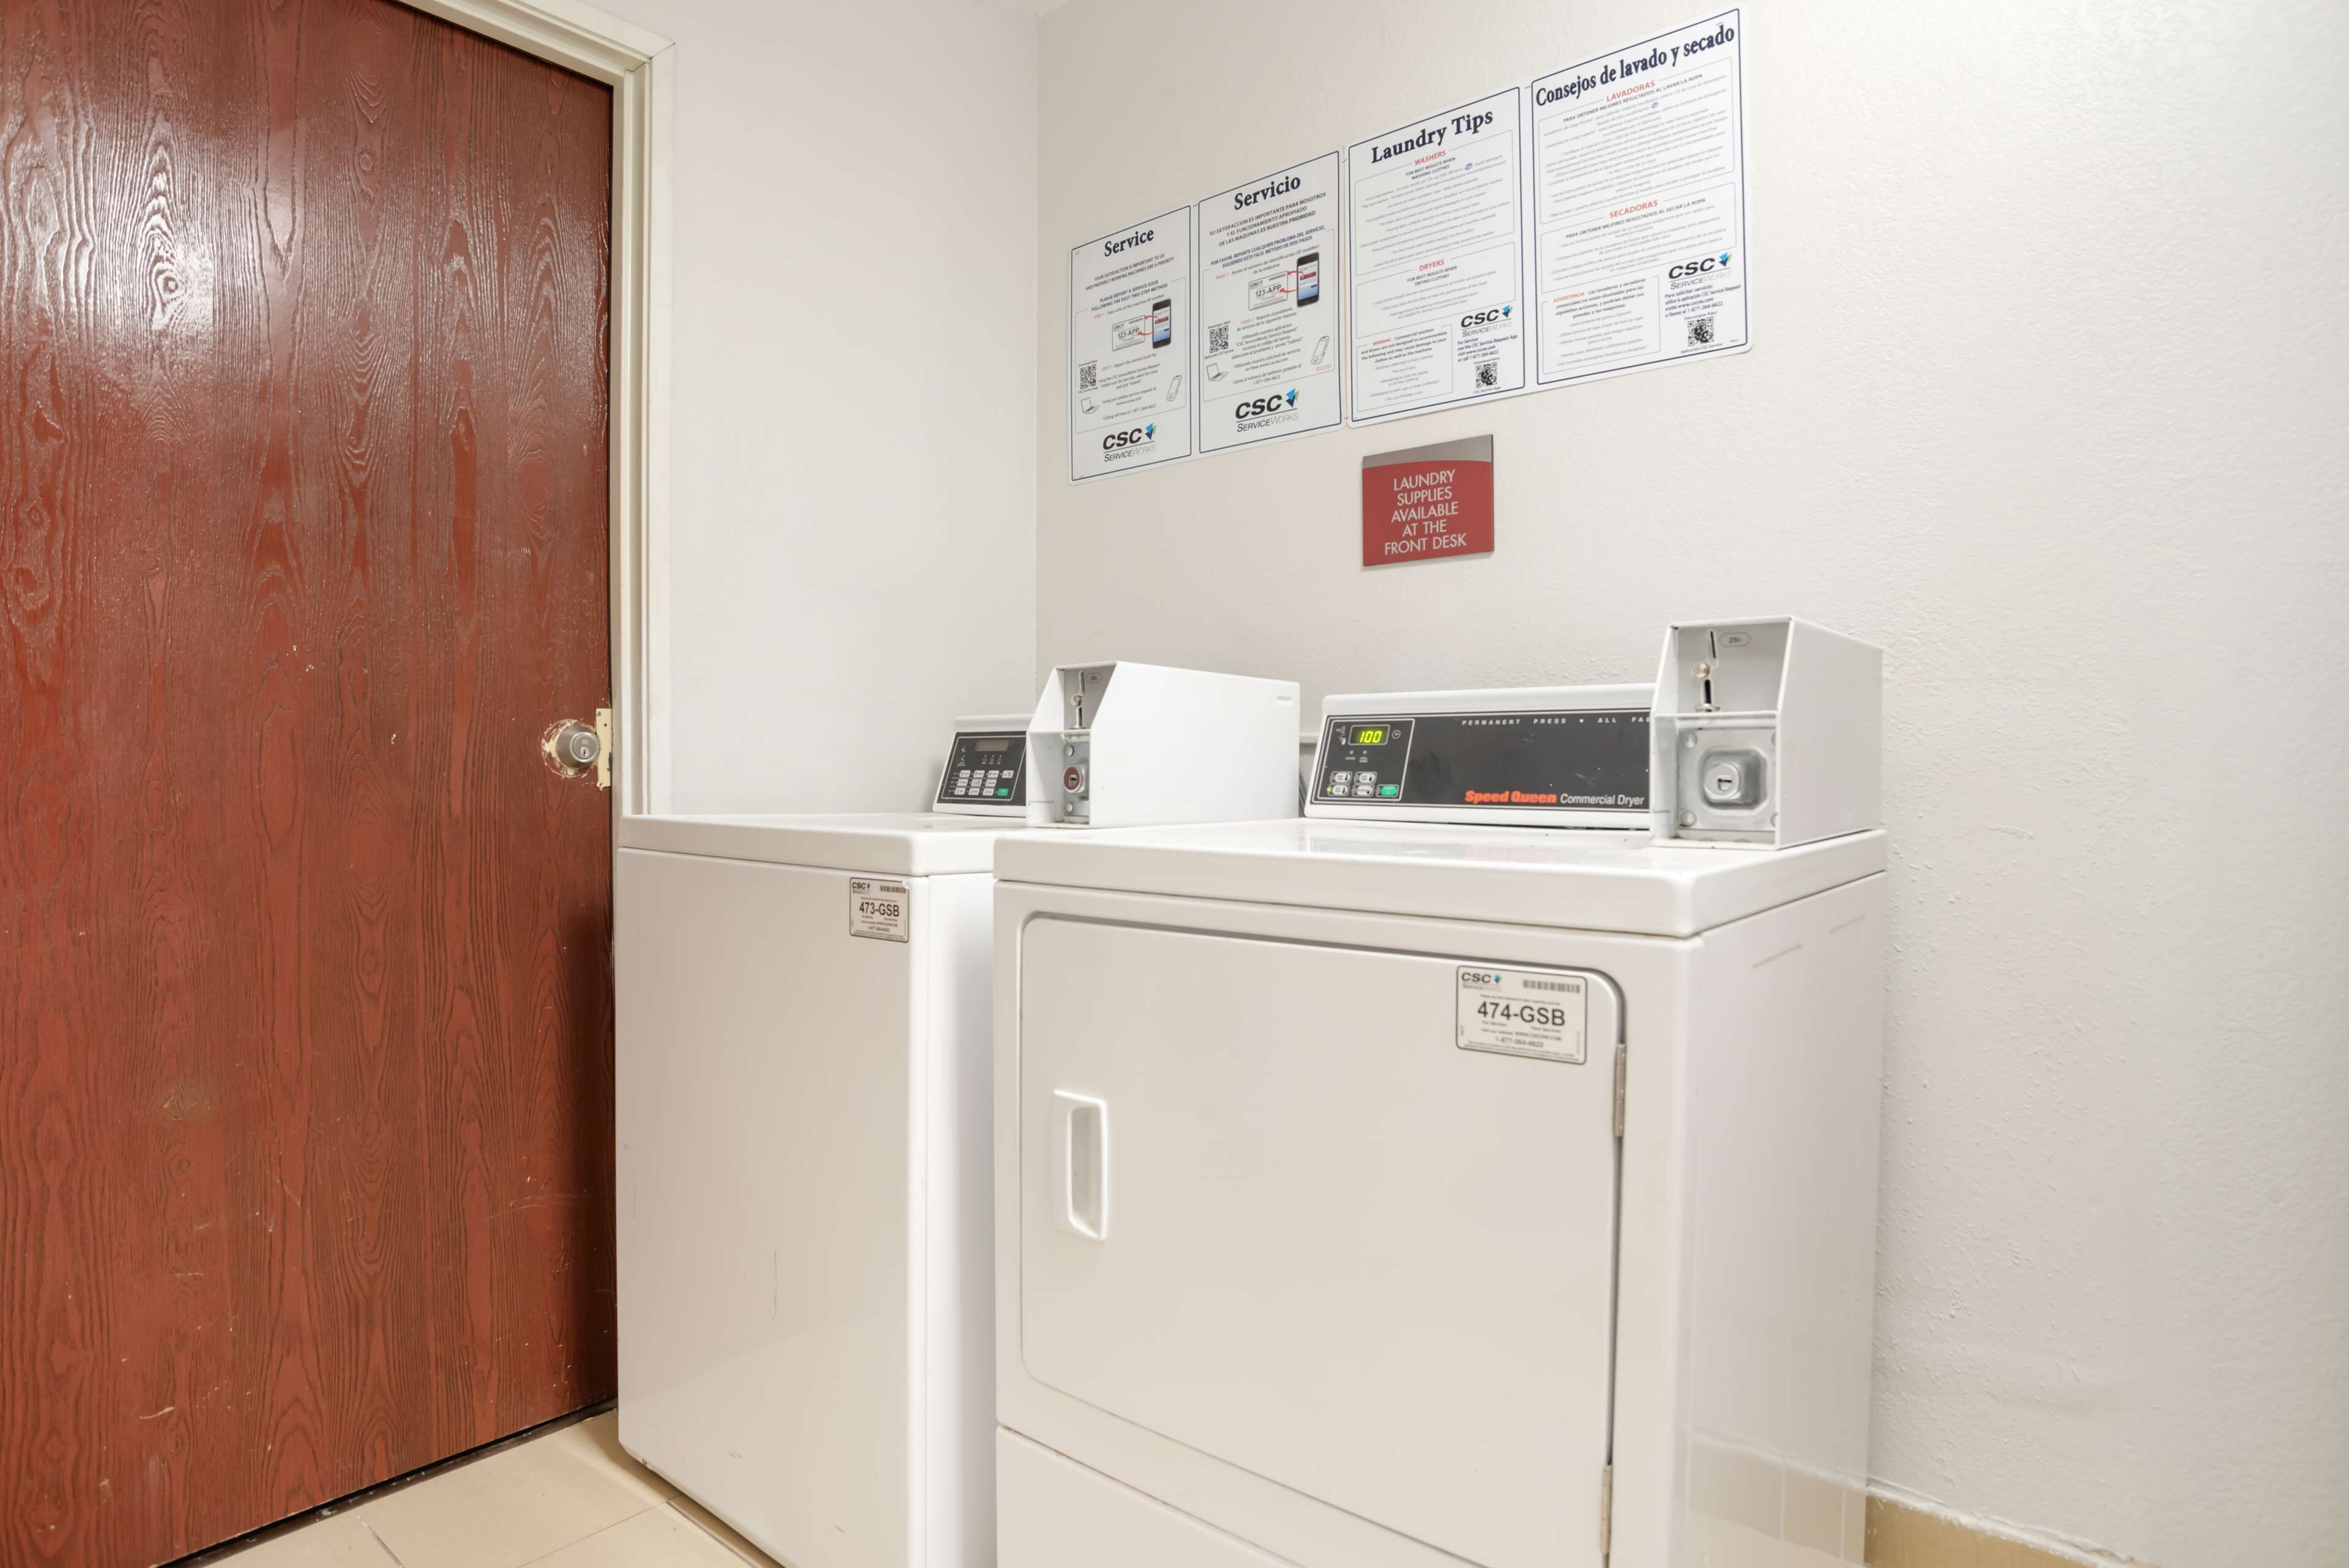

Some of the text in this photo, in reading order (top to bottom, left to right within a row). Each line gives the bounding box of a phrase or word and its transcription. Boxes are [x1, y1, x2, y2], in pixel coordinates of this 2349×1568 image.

[1536, 24, 1734, 106] Consejos de lavado y secado
[1576, 108, 1598, 117] OBTENER
[1599, 100, 1621, 110] MEJORES
[1622, 89, 1654, 103] RESULTADOS
[1662, 81, 1679, 90] LAVAR
[1606, 80, 1655, 102] LAVADORAS
[1371, 111, 1492, 163] Laundry Tips
[1414, 150, 1445, 165] WASHERS
[1424, 161, 1442, 169] RESULTS
[1411, 165, 1449, 179] WASHING CLOTHES
[1234, 176, 1300, 210] Servicio
[1216, 219, 1248, 233] SATISFACCION
[1254, 206, 1284, 220] IMPORTANTE
[1299, 191, 1326, 204] NOSOTROS
[1236, 215, 1278, 233] FUNCIONAMIENTO
[1278, 206, 1307, 218] APROPIADO
[1609, 199, 1658, 218] SECADORAS
[1235, 229, 1259, 240] MAQUINAS
[1266, 220, 1288, 230] NUESTRA
[1289, 210, 1316, 223] PRIORIDAD
[1579, 226, 1601, 234] OBTENER
[1602, 220, 1624, 228] MEJORES
[1625, 211, 1657, 222] RESULTADOS
[1104, 230, 1153, 256] Service
[1093, 279, 1110, 288] PROPERLY
[1111, 273, 1127, 281] WORKING
[1128, 266, 1146, 276] MACHINES
[1157, 256, 1174, 266] PRIORITY
[1104, 266, 1128, 277] SATISFACTION
[1132, 257, 1153, 267] IMPORTANT
[1419, 259, 1444, 271] DRYERS
[1669, 258, 1714, 279] CSC
[1091, 301, 1112, 311] FOLLOWING
[1131, 288, 1150, 297] TWO-STEP
[1150, 283, 1167, 291] METHOD
[1131, 283, 1147, 292] SERVICE
[1461, 309, 1498, 327] CSC
[1235, 395, 1282, 418] CSC
[1103, 428, 1142, 450] CSC
[1394, 469, 1456, 491] LAUNDRY
[1397, 486, 1452, 506] SUPPLIES
[1391, 501, 1458, 522] AVAILABLE
[1402, 519, 1446, 537] AT THE
[1385, 533, 1467, 555] FRONT DESK
[1360, 730, 1382, 743] 100
[1465, 790, 1644, 807] Speed Queen Commercial Dryer
[859, 901, 899, 916] 473-GSB
[1461, 972, 1491, 983] CSC
[1477, 1001, 1565, 1027] 474-GSB
